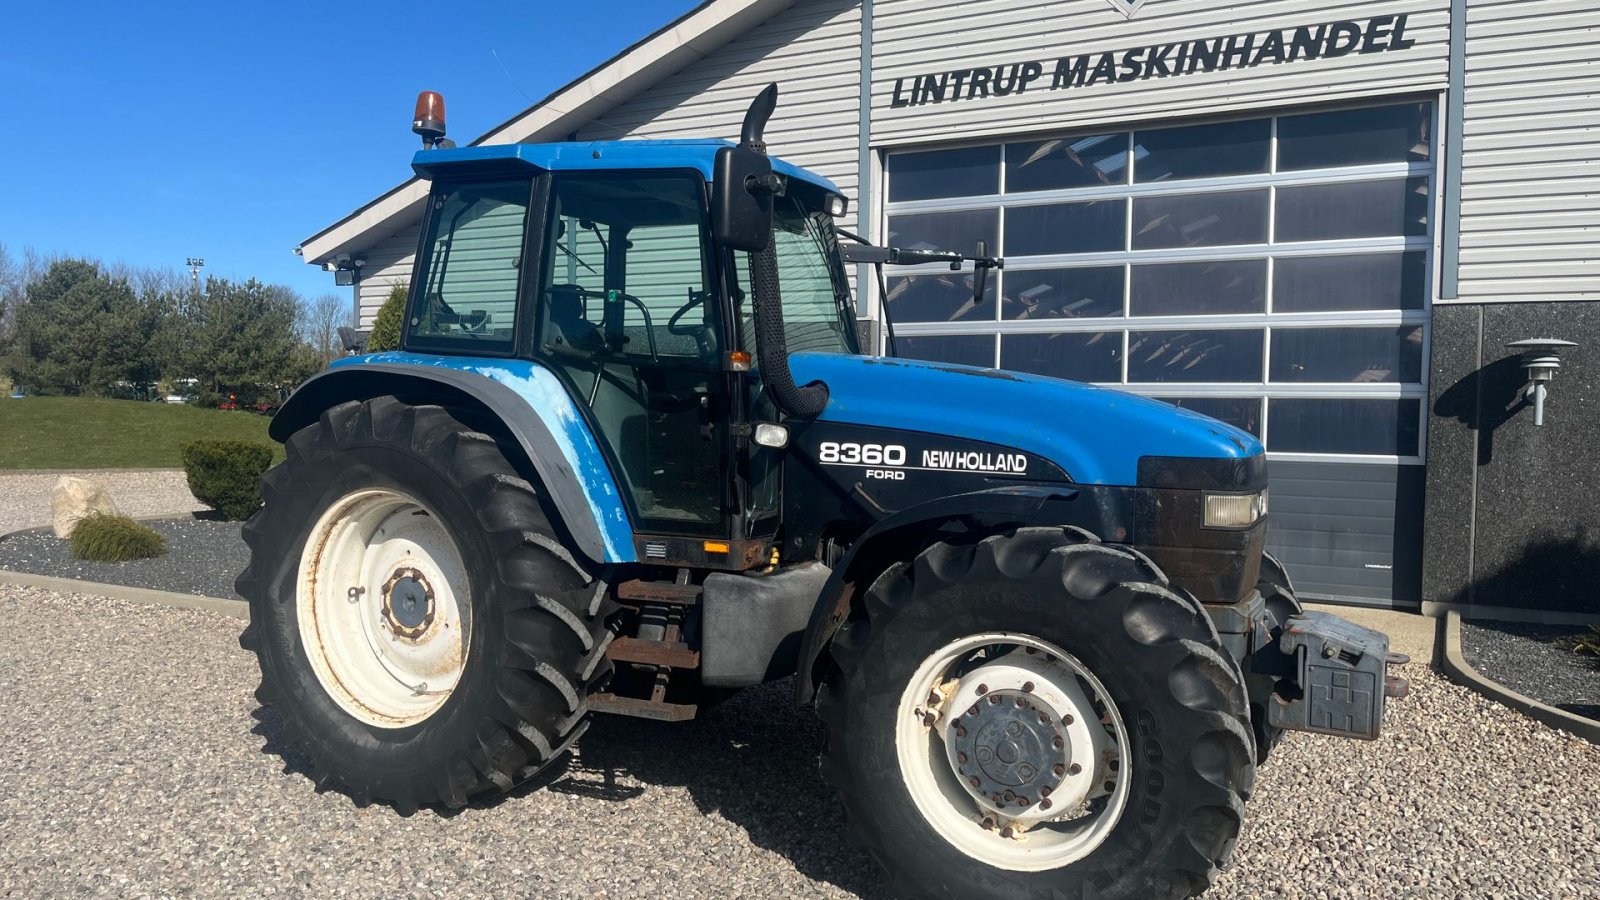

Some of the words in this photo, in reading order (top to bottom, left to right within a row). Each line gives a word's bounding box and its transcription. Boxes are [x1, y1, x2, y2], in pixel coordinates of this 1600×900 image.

[890, 62, 1042, 108] LINTRUP
[1050, 14, 1416, 90] MASKINHANDEL
[819, 441, 906, 466] 8360
[922, 450, 953, 469] NEW
[955, 451, 1027, 472] HOLLAND
[866, 469, 905, 481] FORD
